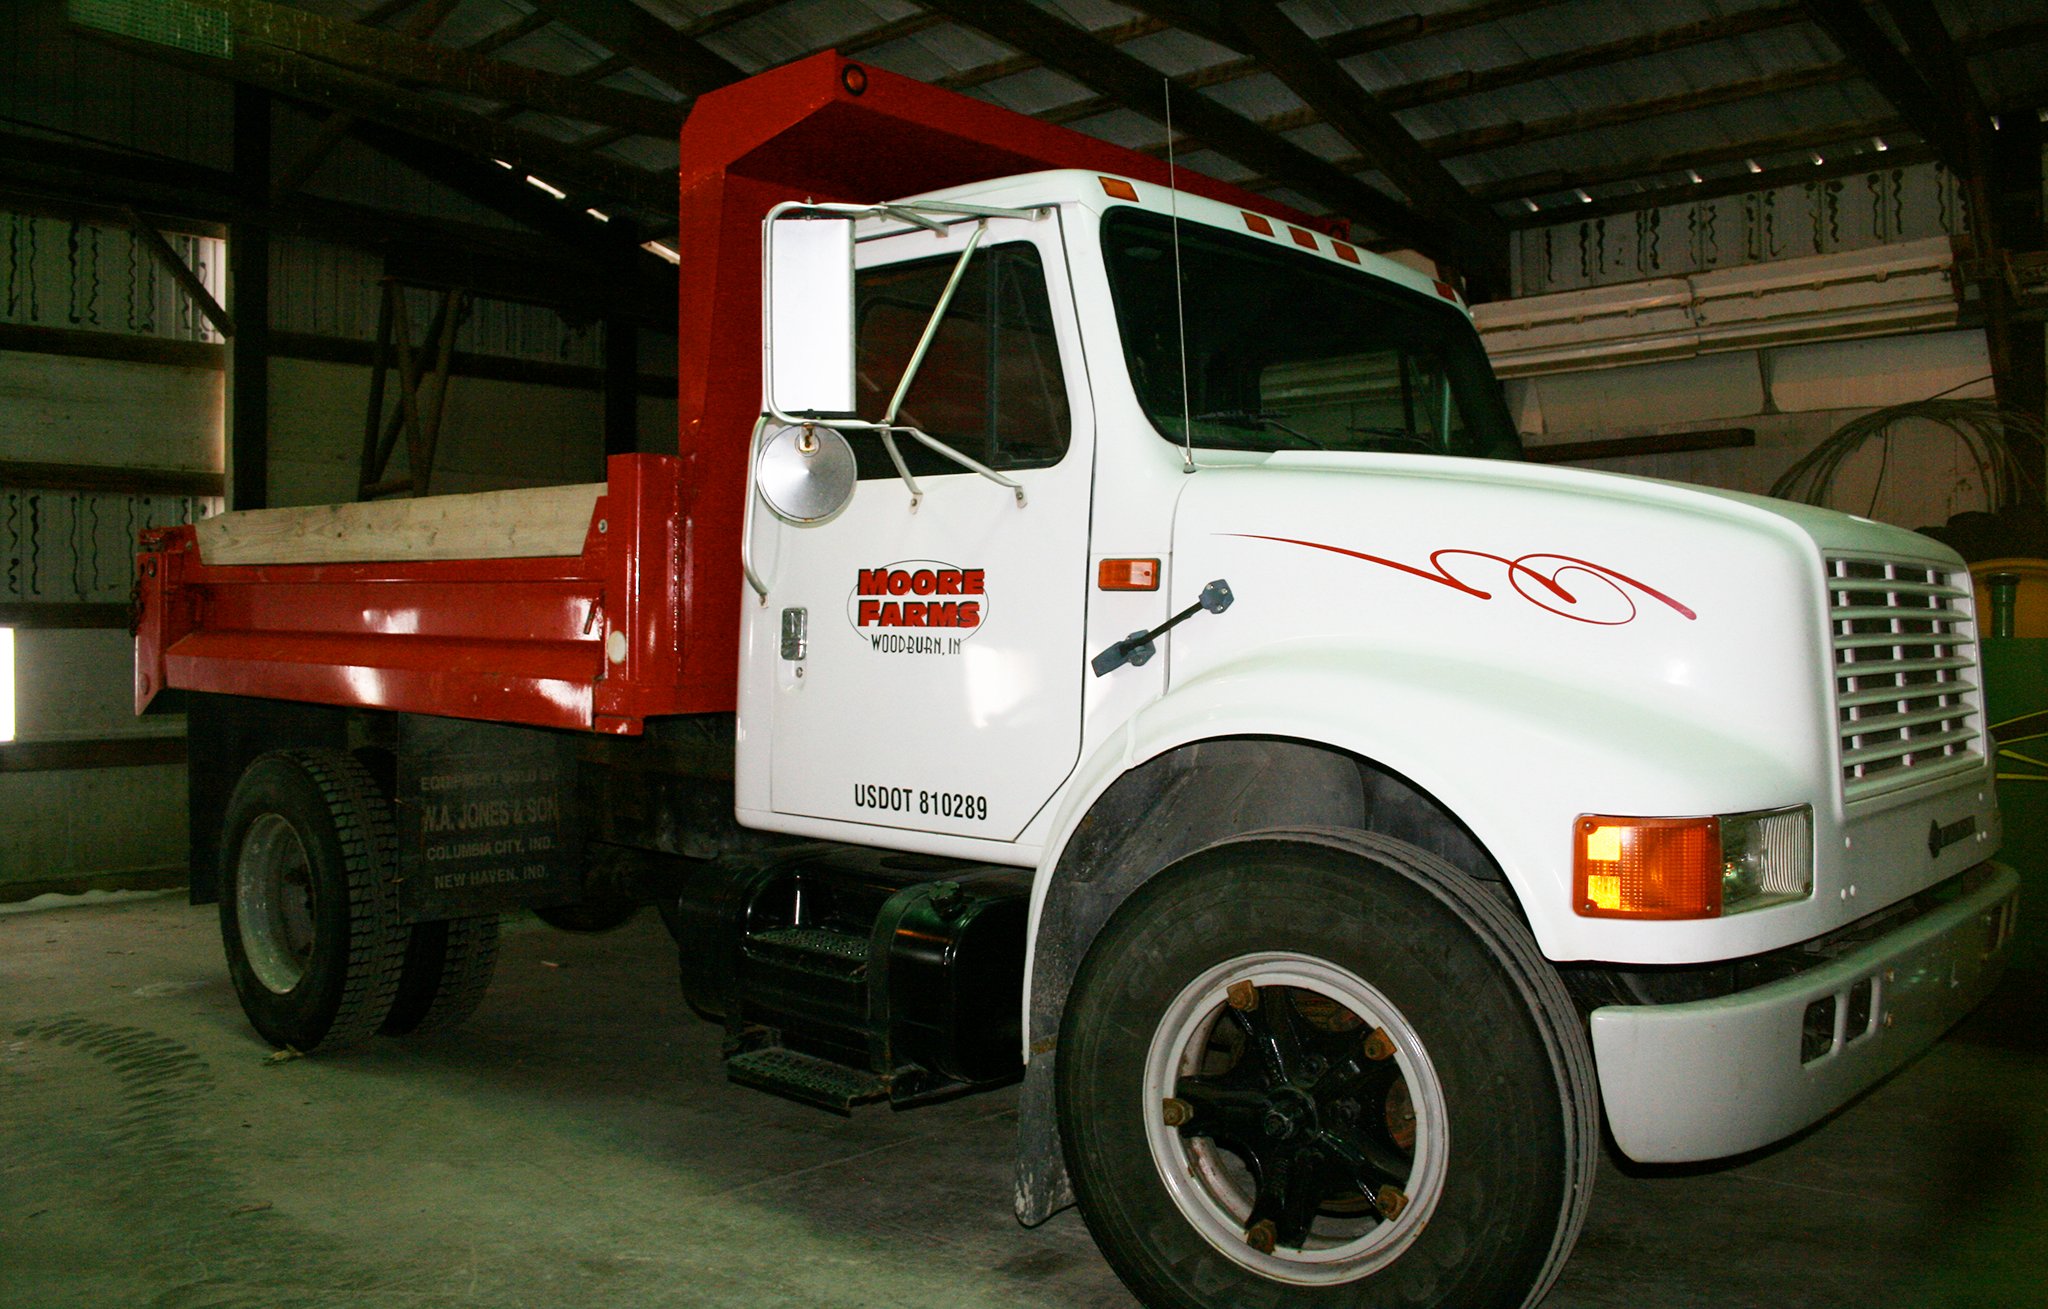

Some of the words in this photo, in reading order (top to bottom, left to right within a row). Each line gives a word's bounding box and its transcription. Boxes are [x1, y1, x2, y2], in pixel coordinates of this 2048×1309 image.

[857, 568, 985, 596] MOORE
[857, 600, 980, 628] FARMS
[871, 633, 946, 656] WOODBURN,
[948, 637, 961, 655] IN
[458, 800, 510, 829] JONES
[513, 799, 524, 824] &
[527, 795, 560, 823] SON
[854, 783, 912, 812] USDOT
[919, 790, 987, 820] 810289
[426, 842, 492, 860] COLUMBIA
[434, 872, 466, 890] NEW
